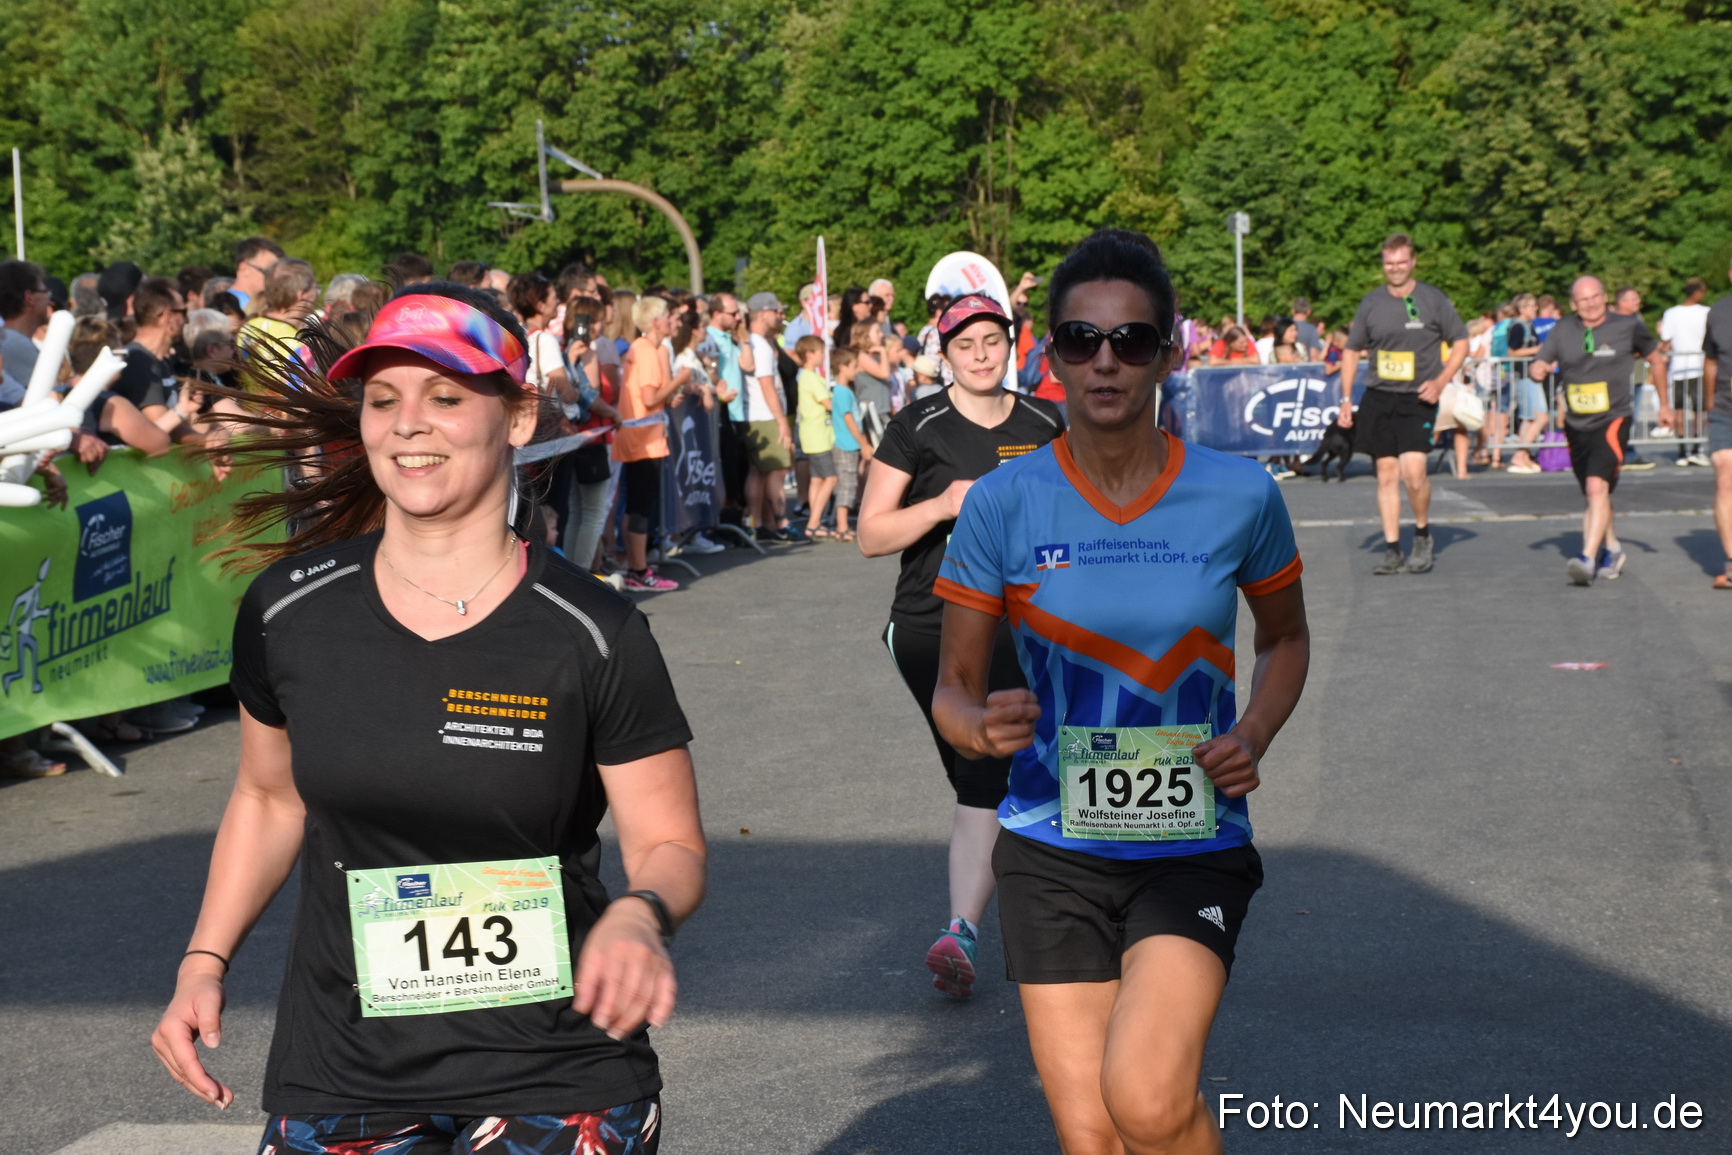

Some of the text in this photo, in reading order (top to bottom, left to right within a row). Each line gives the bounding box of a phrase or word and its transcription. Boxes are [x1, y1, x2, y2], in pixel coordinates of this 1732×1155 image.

[1077, 538, 1170, 553] Raiffeisenbank
[306, 559, 336, 576] JAKO
[1077, 552, 1140, 566] Neumarkt
[1192, 553, 1209, 564] eG
[47, 556, 176, 660] firmenlauf
[50, 644, 109, 683] neumarkt
[448, 688, 549, 706] BERSCHNEIDER
[446, 703, 547, 720] BERSCHNEIDER
[443, 721, 545, 738] ARCHITEKTEN BDA
[442, 735, 543, 752] INNENARCHITEKTEN
[1081, 748, 1141, 760] firmenlauf
[1175, 755, 1195, 766] 201
[1078, 767, 1194, 809] 1925
[1078, 809, 1196, 821] Wolfsteiner Josefine
[1070, 819, 1122, 829] Raiffeisenbank
[1194, 820, 1205, 828] eG
[384, 892, 464, 912] firmenlauf
[512, 897, 549, 911] 2019
[1198, 909, 1226, 932] adidas
[404, 915, 518, 972] 143
[388, 966, 541, 990] Von Hanstein Elena
[372, 989, 443, 1003] Berschneider
[454, 983, 524, 997] Berschneider
[527, 977, 560, 990] GmbH
